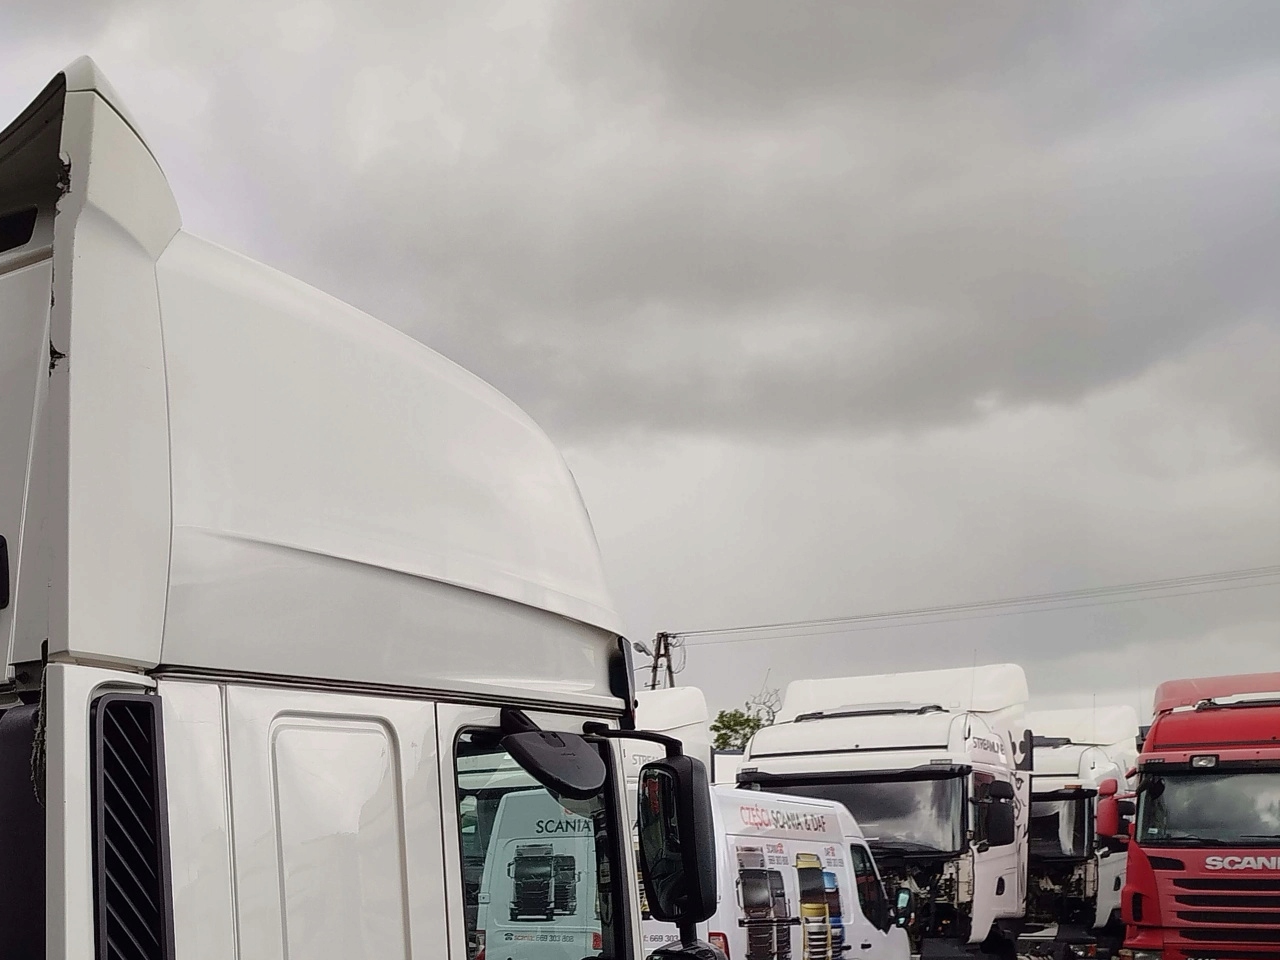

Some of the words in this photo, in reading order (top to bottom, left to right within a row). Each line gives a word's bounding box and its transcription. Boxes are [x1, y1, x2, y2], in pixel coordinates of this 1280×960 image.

[536, 819, 592, 834] SCANIA
[771, 810, 804, 831] SCANIA
[811, 814, 826, 832] DAF
[649, 934, 664, 942] 669
